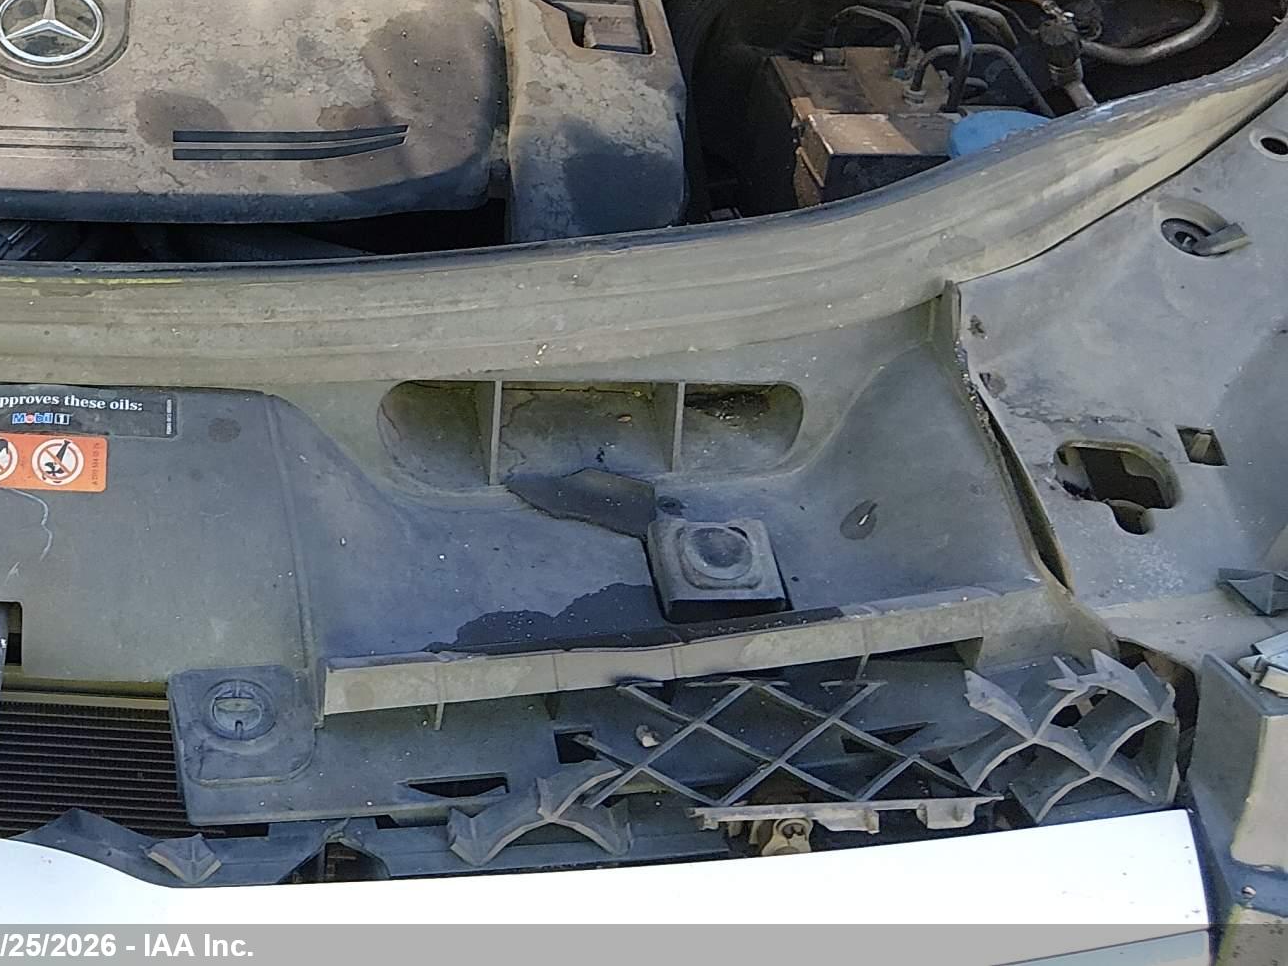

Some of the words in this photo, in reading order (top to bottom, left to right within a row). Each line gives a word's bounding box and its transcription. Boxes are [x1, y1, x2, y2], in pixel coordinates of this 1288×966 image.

[64, 395, 106, 409] these
[109, 399, 143, 411] oils:
[12, 412, 53, 425] Mobil
